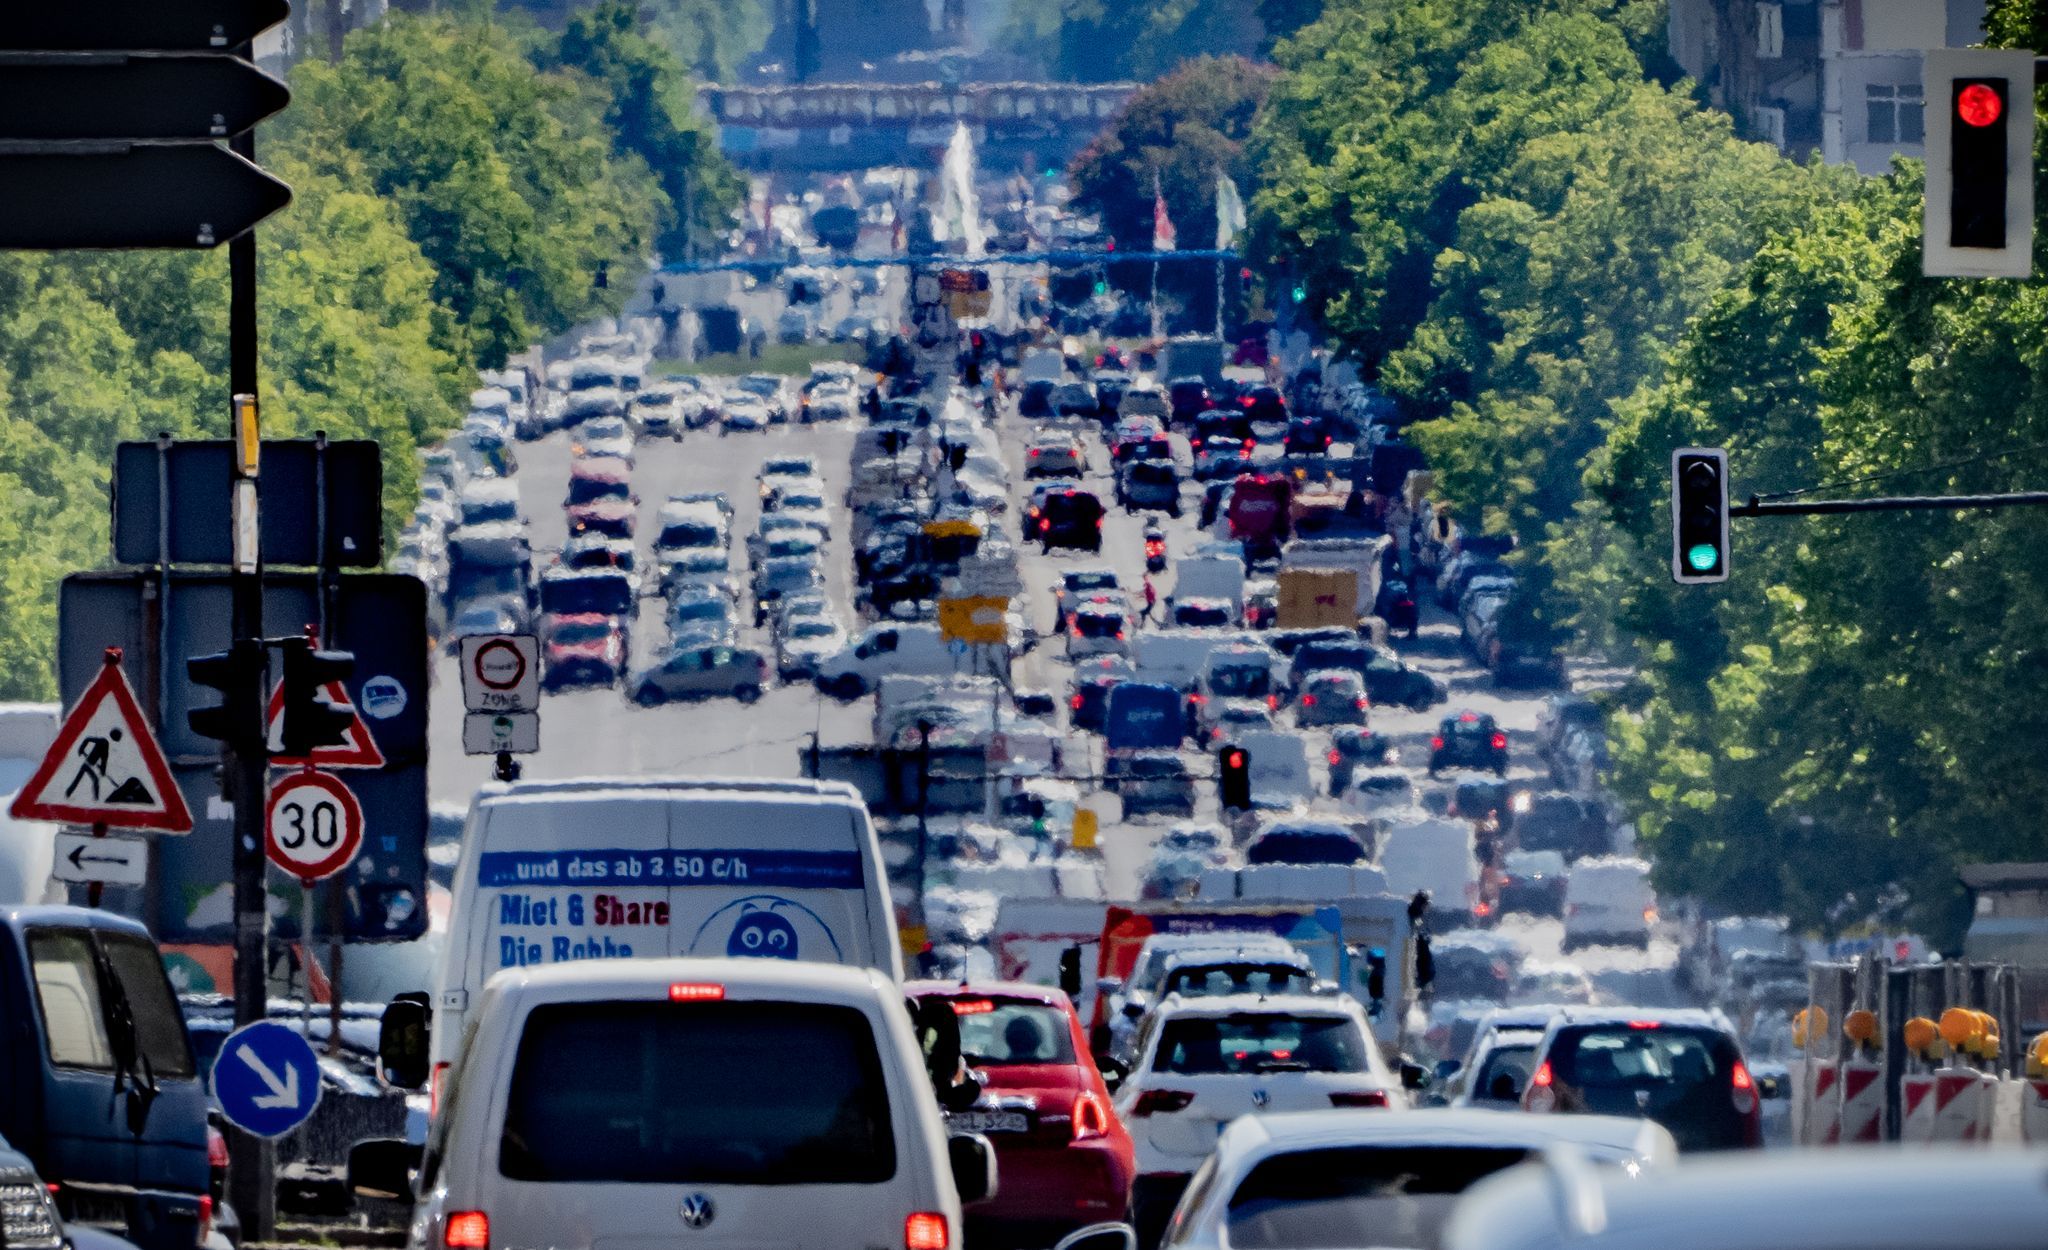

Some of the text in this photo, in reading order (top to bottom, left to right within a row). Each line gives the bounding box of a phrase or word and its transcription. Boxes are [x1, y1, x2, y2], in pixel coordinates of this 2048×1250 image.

[281, 801, 338, 849] 30
[567, 856, 608, 879] das
[615, 856, 643, 878] ab
[500, 893, 559, 927] Miet
[594, 893, 671, 927] Share
[500, 935, 543, 968] Die
